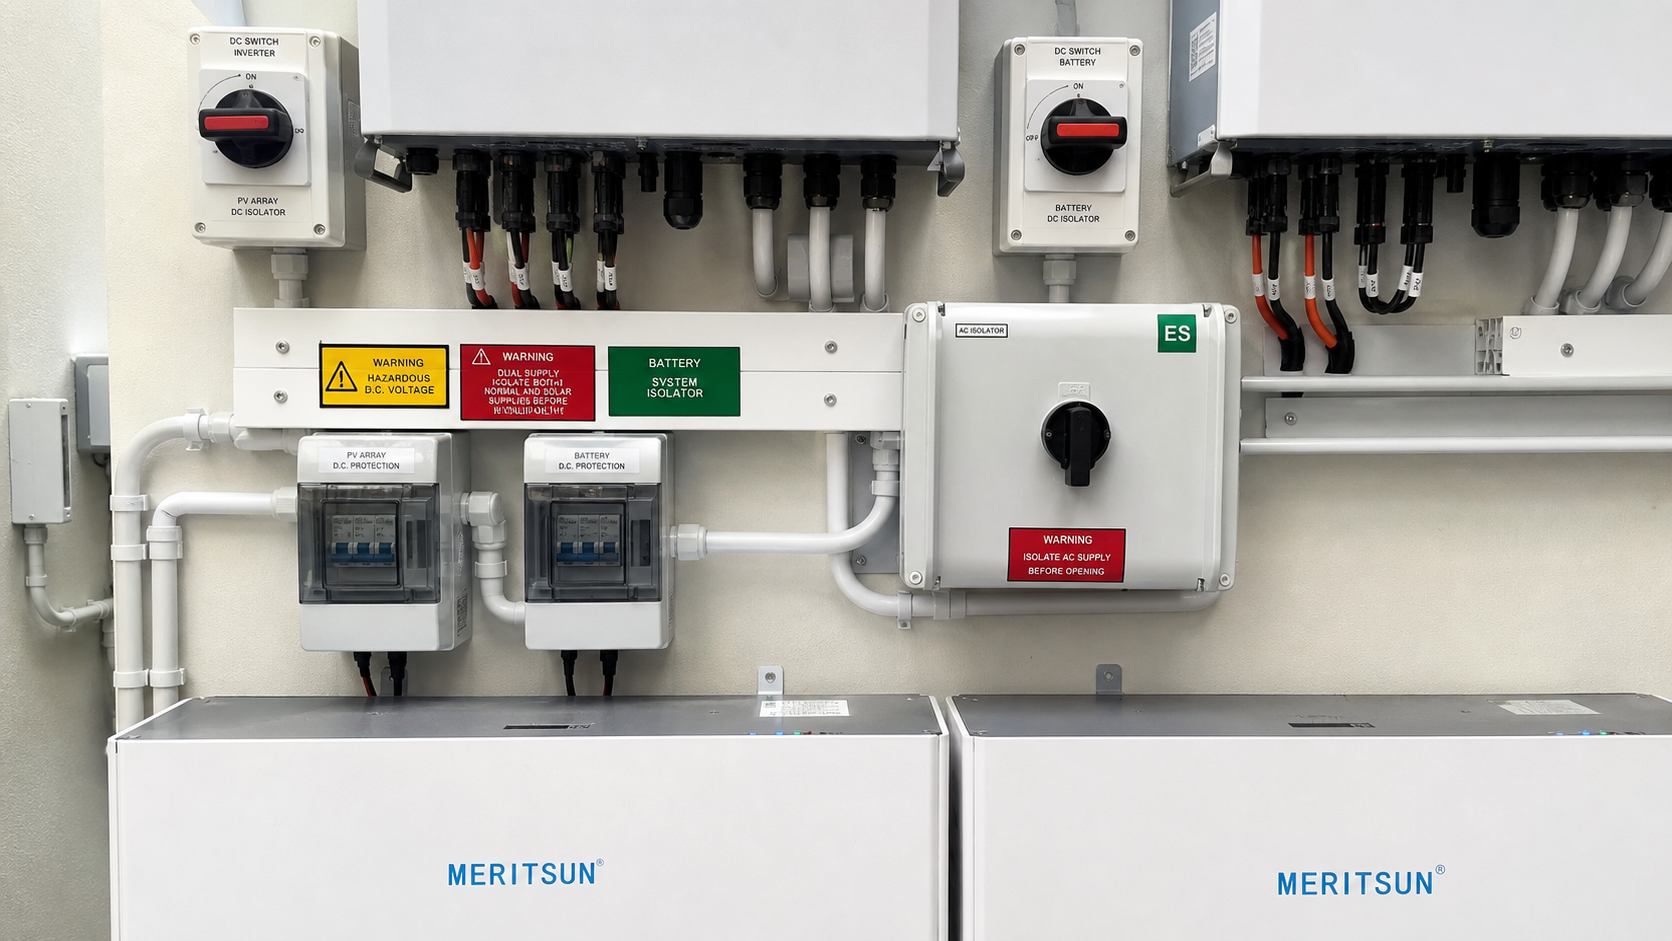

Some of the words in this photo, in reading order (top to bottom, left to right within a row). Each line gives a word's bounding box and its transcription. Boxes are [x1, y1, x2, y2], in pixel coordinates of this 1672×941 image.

[229, 36, 243, 46] DC
[244, 37, 279, 46] SWITCH
[234, 48, 276, 57] INVERTER
[1054, 47, 1067, 55] DC
[1068, 47, 1102, 56] SWITCH
[1059, 58, 1097, 67] BATTERY
[1073, 82, 1084, 90] ON
[231, 208, 243, 216] DC
[244, 208, 286, 216] ISOLATOR
[1055, 204, 1093, 212] BATTERY
[1047, 215, 1059, 223] DC
[1060, 215, 1100, 223] ISOLATOR
[1164, 324, 1191, 342] ES
[502, 352, 554, 362] WARNING
[372, 358, 424, 368] WARNING
[648, 358, 702, 368] BATTERY
[367, 373, 431, 383] HAZARDOUS
[497, 369, 522, 377] DUAL
[524, 369, 560, 378] SUPPLY
[388, 385, 435, 395] VOLTAGE
[646, 388, 704, 398] ISOLATOR
[346, 451, 358, 459] PV
[359, 451, 387, 459] ARRAY
[574, 451, 610, 460] BATTERY
[332, 461, 349, 470] D.C.
[350, 461, 400, 470] PROTECTION
[558, 462, 574, 470] D.C.
[575, 462, 625, 470] PROTECTION
[1043, 535, 1093, 545] WARNING
[1023, 552, 1061, 561] ISOLATE
[1062, 553, 1075, 561] AC
[1077, 553, 1112, 562] SUPPLY
[1028, 567, 1063, 575] BEFORE
[1065, 567, 1105, 576] OPENING
